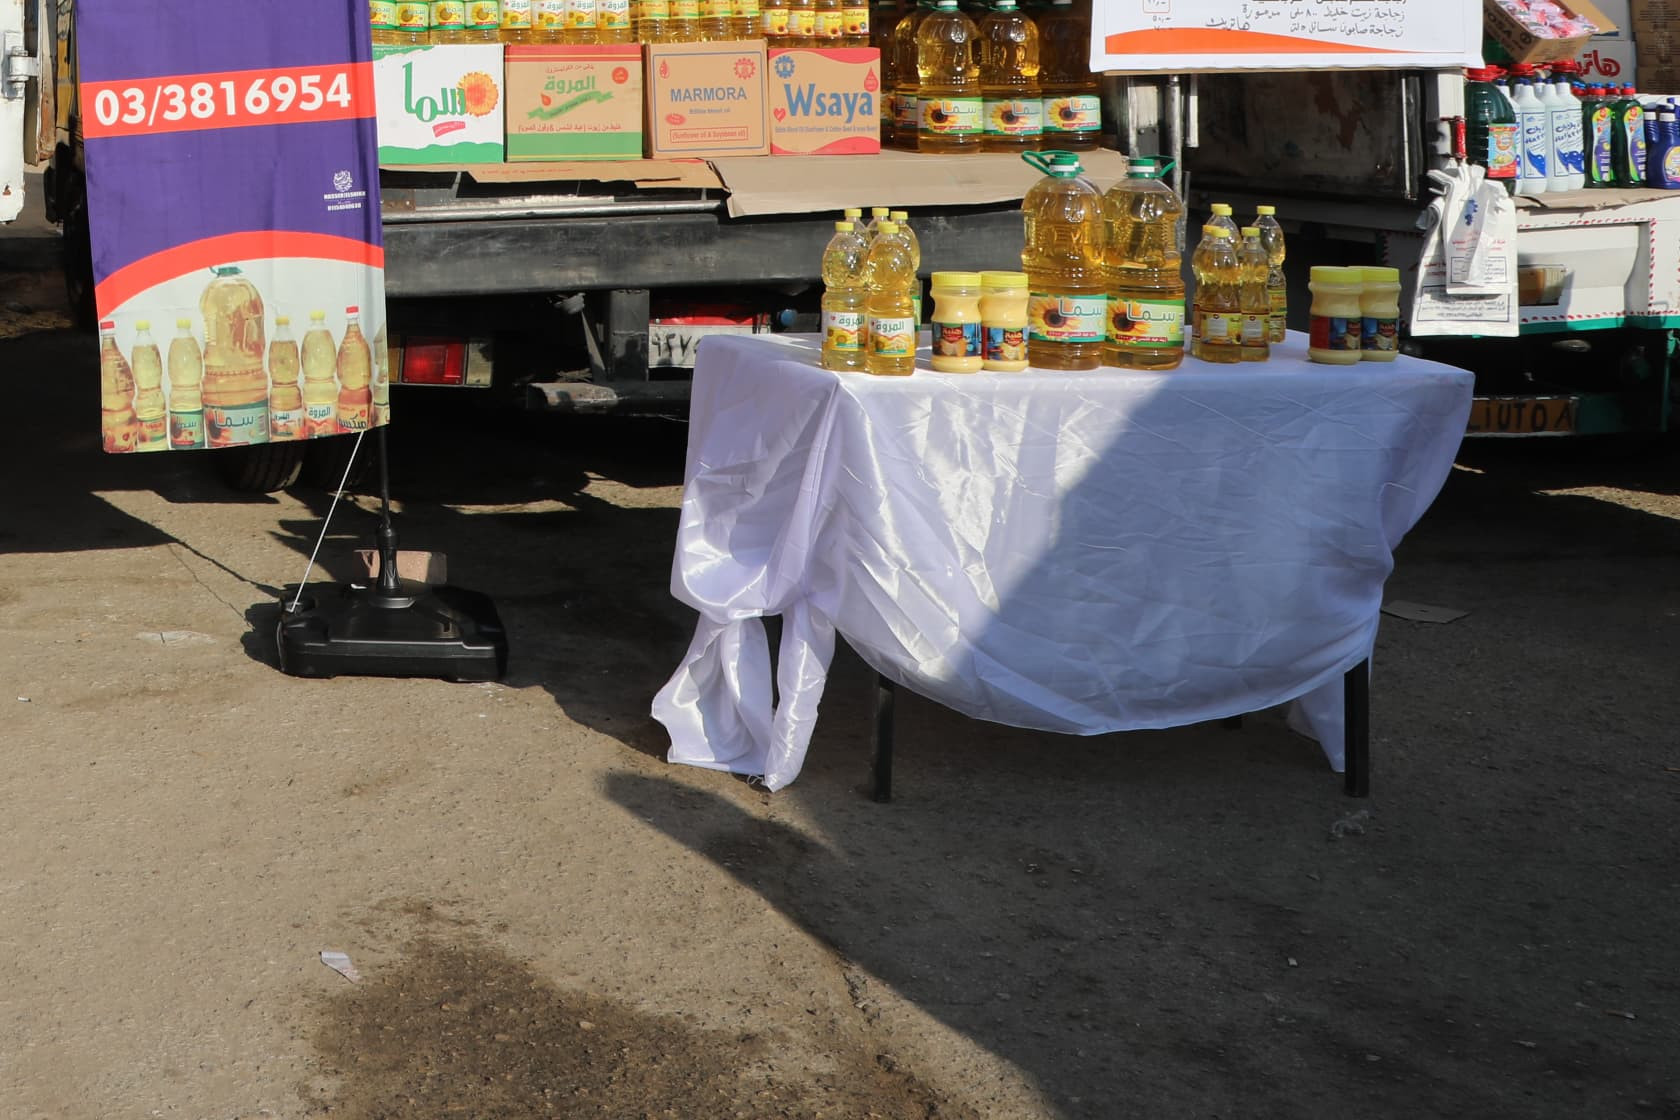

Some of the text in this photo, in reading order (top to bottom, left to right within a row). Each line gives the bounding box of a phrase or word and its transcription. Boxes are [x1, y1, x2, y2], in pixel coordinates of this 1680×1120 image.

[403, 61, 466, 122] سما
[545, 75, 596, 95] المروة
[671, 87, 747, 102] MARMORA
[94, 72, 351, 127] 03/3816954
[784, 83, 873, 123] Wsaya
[1058, 298, 1103, 317] سما
[1127, 302, 1176, 321] سما
[839, 315, 865, 327] المروة
[876, 320, 905, 333] المروة
